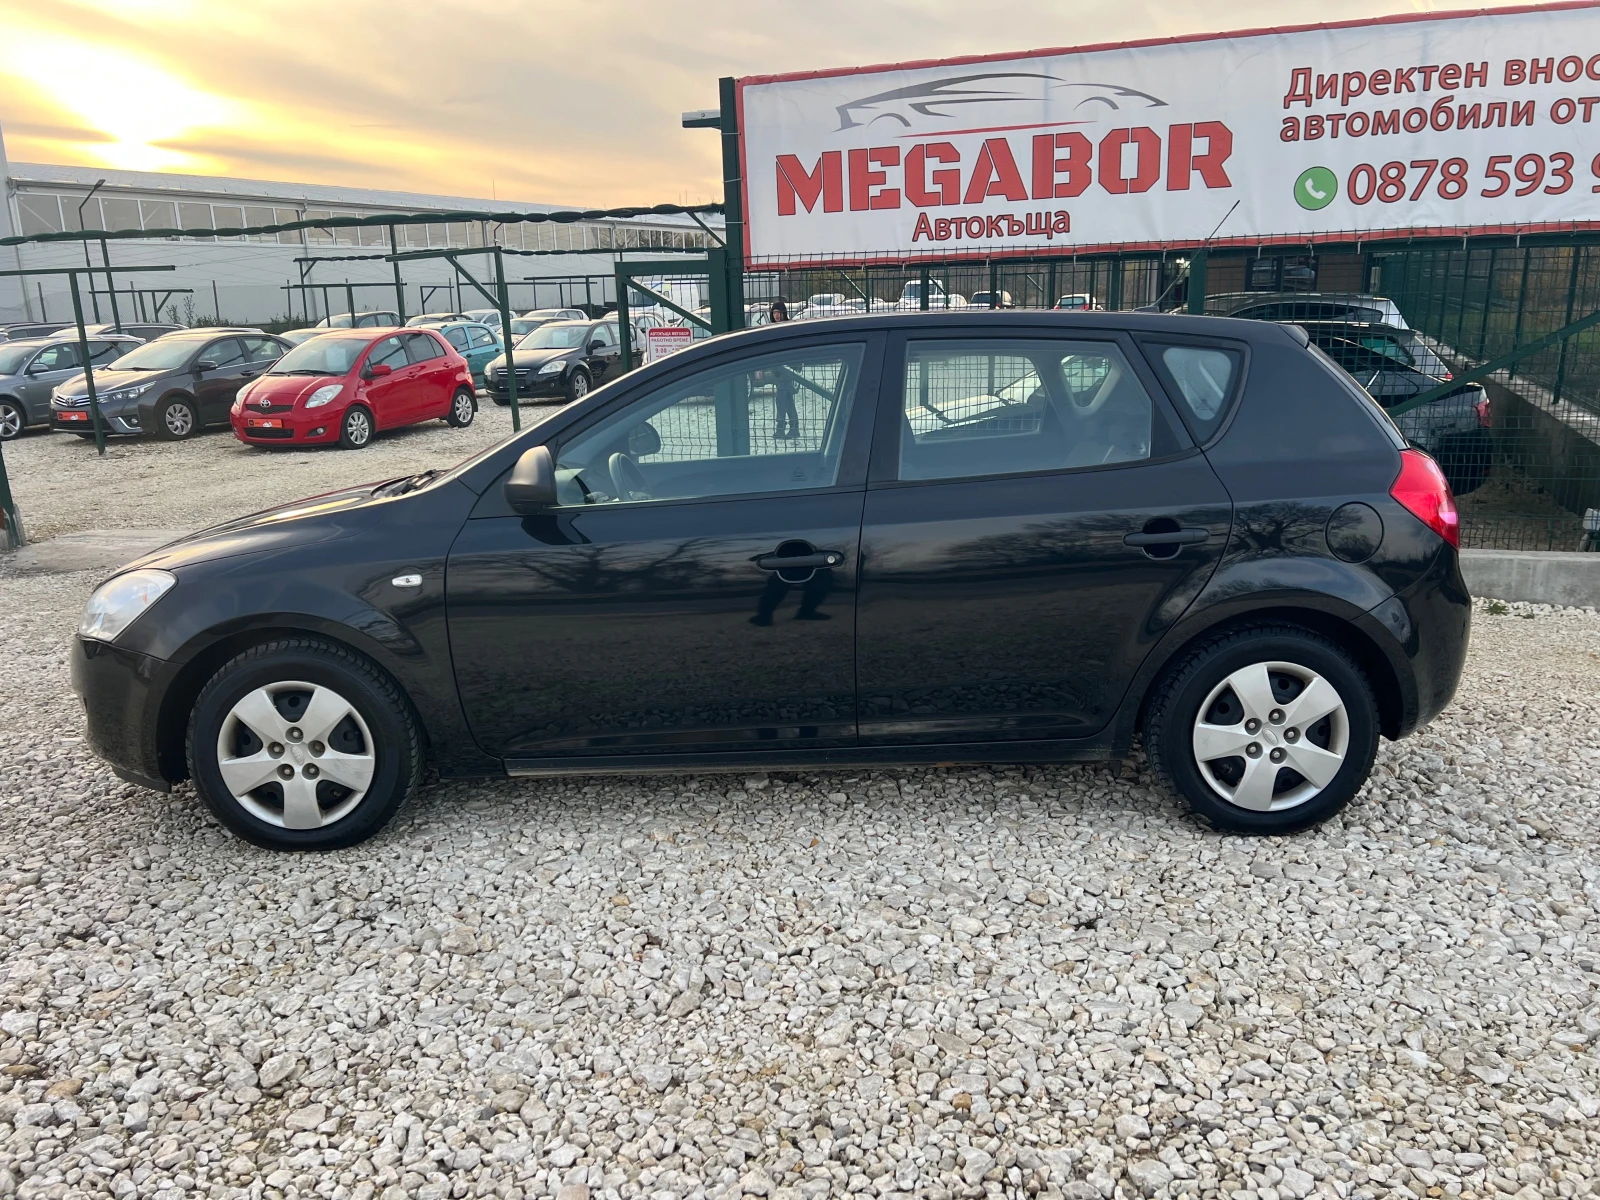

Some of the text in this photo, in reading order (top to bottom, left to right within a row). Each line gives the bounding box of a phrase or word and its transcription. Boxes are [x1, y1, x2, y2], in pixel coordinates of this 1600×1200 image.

[1283, 61, 1489, 109] Директен
[1279, 95, 1600, 142] автомобили от
[775, 120, 1233, 216] MEGABOR
[1347, 157, 1468, 206] 0878
[1480, 151, 1574, 198] 593
[911, 210, 1071, 242] Автокъща
